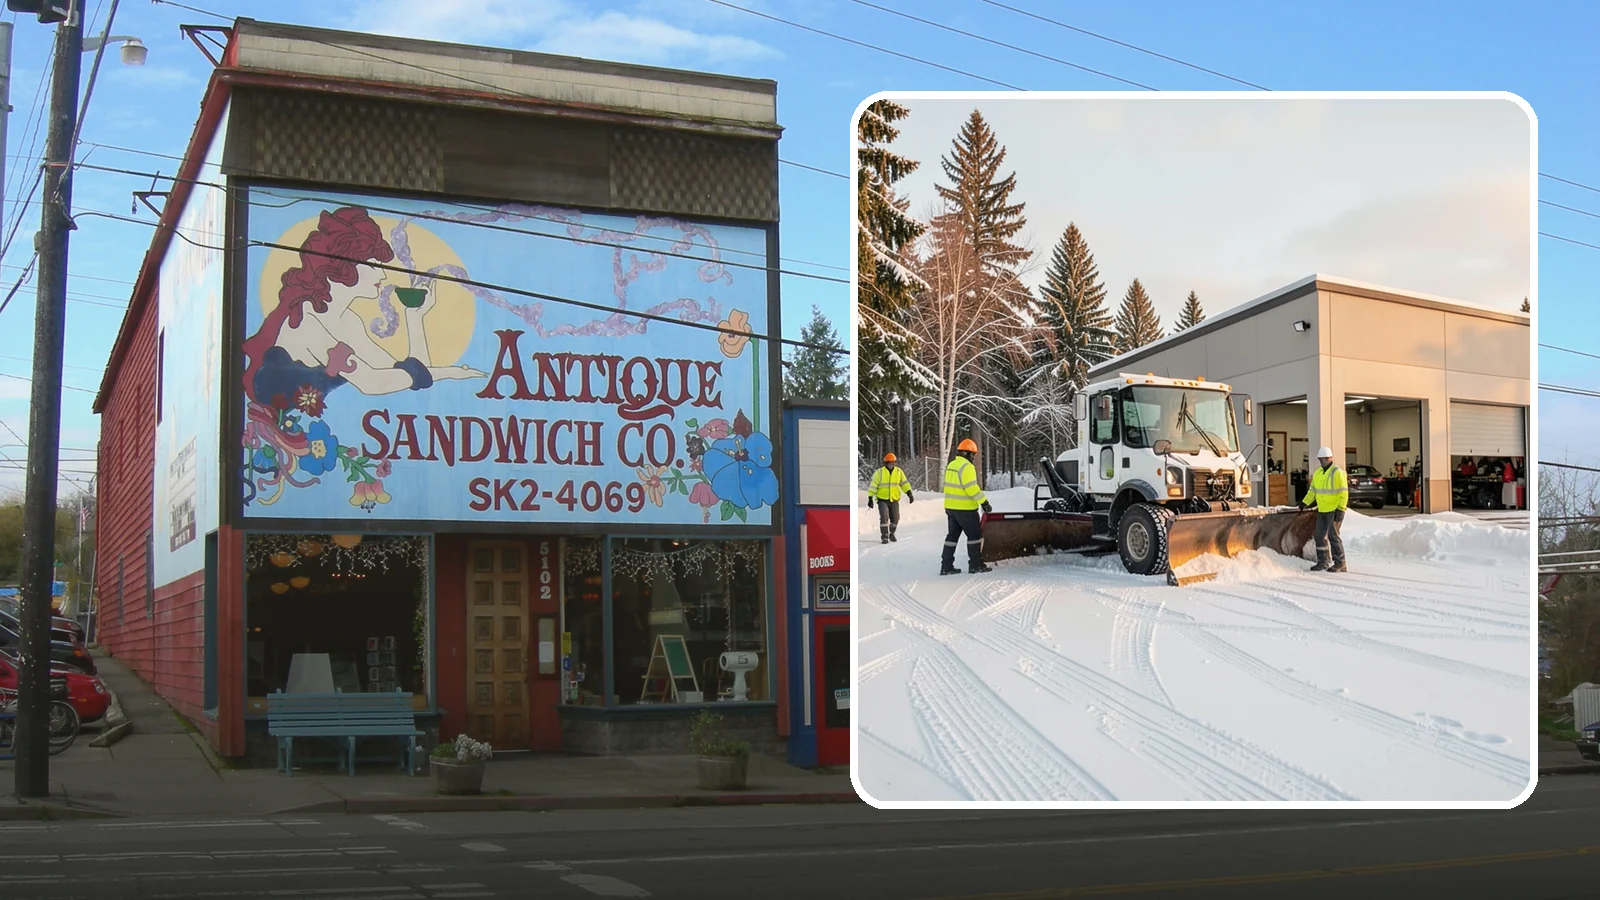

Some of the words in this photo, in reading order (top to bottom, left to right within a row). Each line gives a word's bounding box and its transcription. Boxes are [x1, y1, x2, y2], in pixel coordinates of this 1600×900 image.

[476, 330, 723, 421] ANTIQUE
[361, 409, 604, 466] SANDWICH
[618, 422, 685, 469] CO.
[469, 478, 645, 513] SK2-4069
[540, 541, 551, 600] 5102
[809, 555, 835, 568] BOOKS
